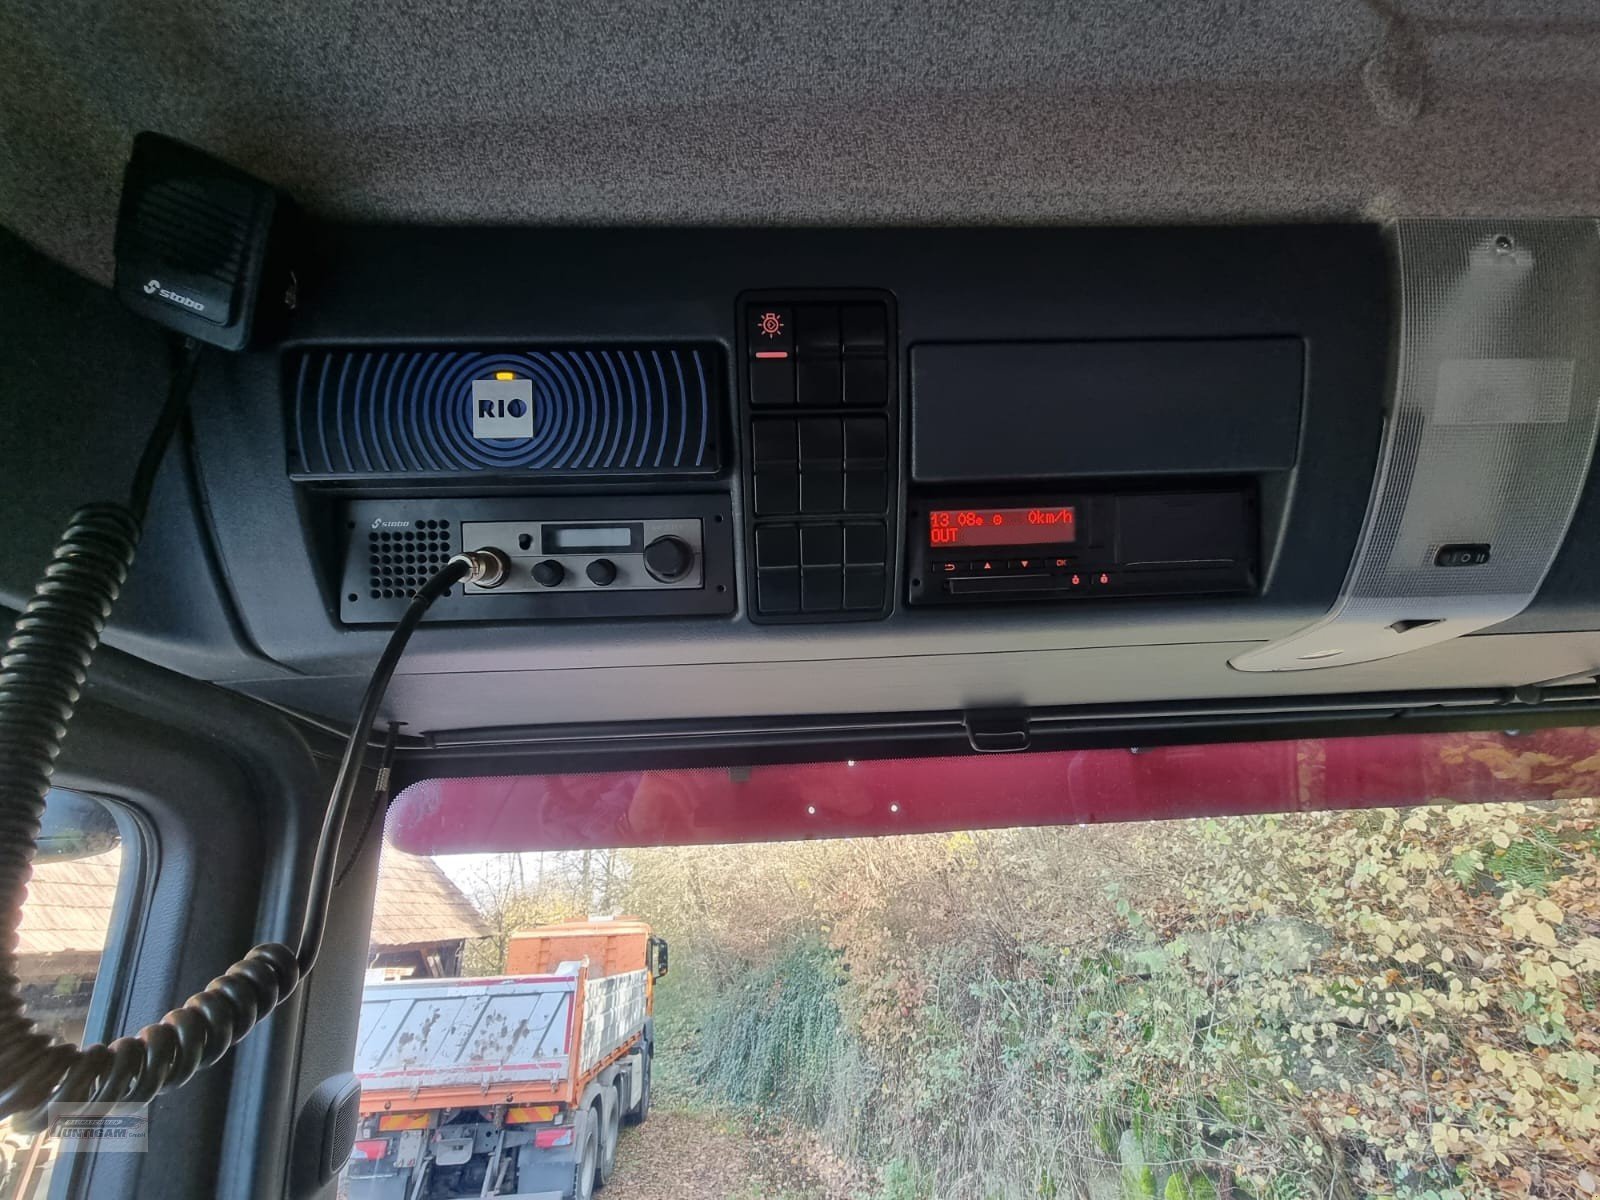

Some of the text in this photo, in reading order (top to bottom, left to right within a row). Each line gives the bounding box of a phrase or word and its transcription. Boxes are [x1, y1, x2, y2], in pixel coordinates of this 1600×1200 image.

[159, 289, 205, 311] stabo
[478, 398, 527, 418] RIO
[1028, 509, 1073, 525] 0km/h
[930, 527, 959, 543] OUT
